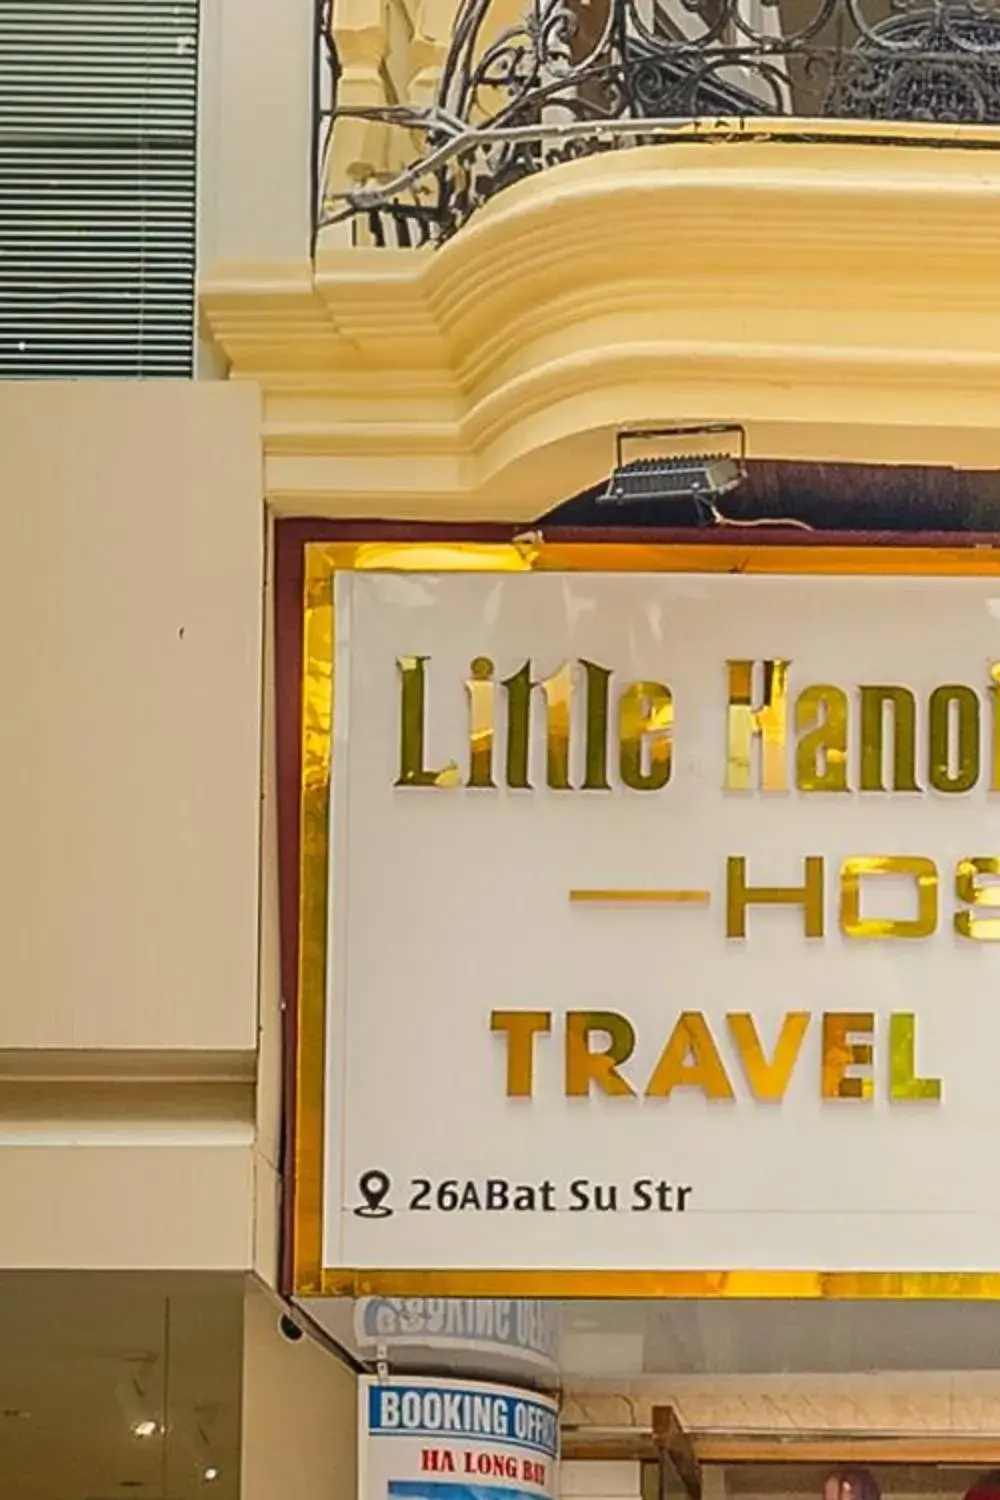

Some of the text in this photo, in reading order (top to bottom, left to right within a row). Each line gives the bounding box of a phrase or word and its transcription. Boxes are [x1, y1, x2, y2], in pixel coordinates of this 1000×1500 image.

[393, 655, 676, 792] Little
[490, 1009, 943, 1101] TRAVEL
[568, 1179, 618, 1212] Su
[631, 1179, 693, 1212] Str
[380, 1391, 508, 1435] BOOKING
[421, 1449, 455, 1472] HA
[463, 1452, 517, 1478] LONG
